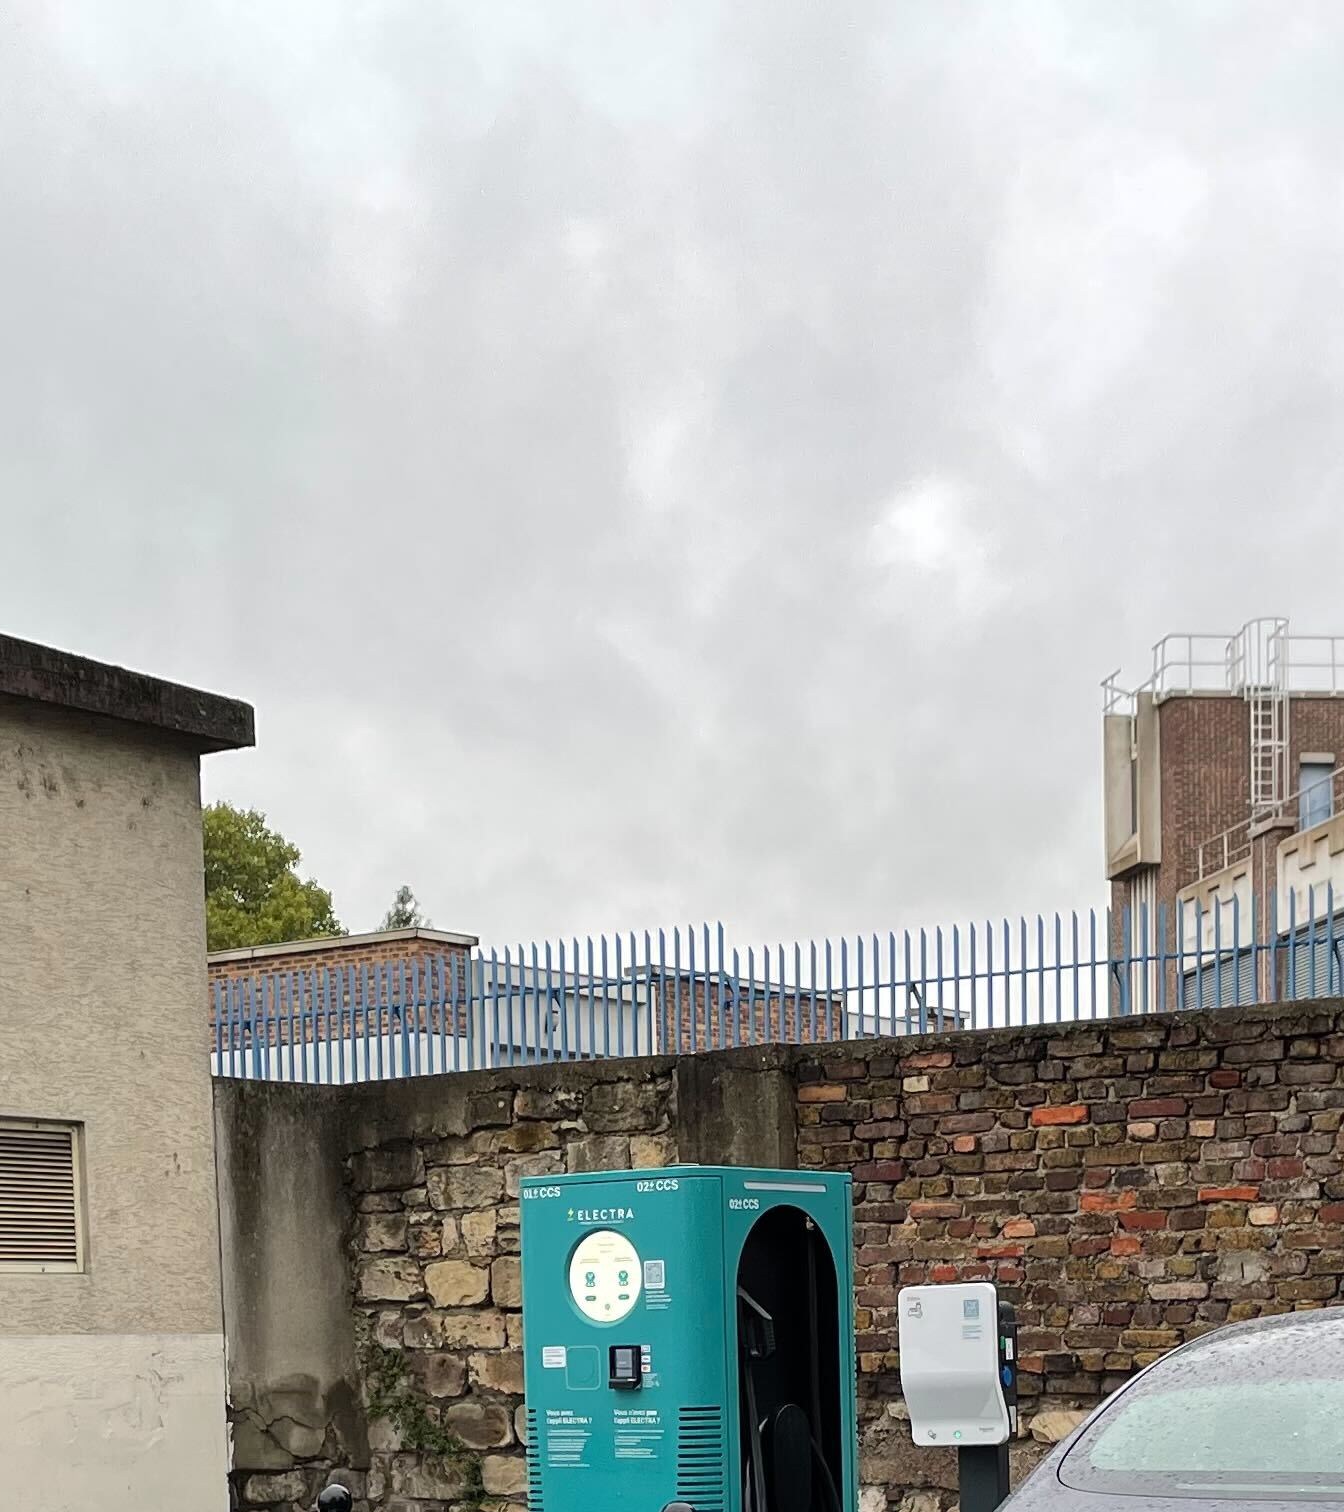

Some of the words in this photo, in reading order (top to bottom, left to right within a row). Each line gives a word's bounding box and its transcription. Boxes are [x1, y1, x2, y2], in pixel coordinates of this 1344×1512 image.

[656, 1180, 679, 1191] CCS
[539, 1186, 561, 1198] CCS
[743, 1199, 759, 1210] CCS
[577, 1208, 634, 1221] ELECTRA
